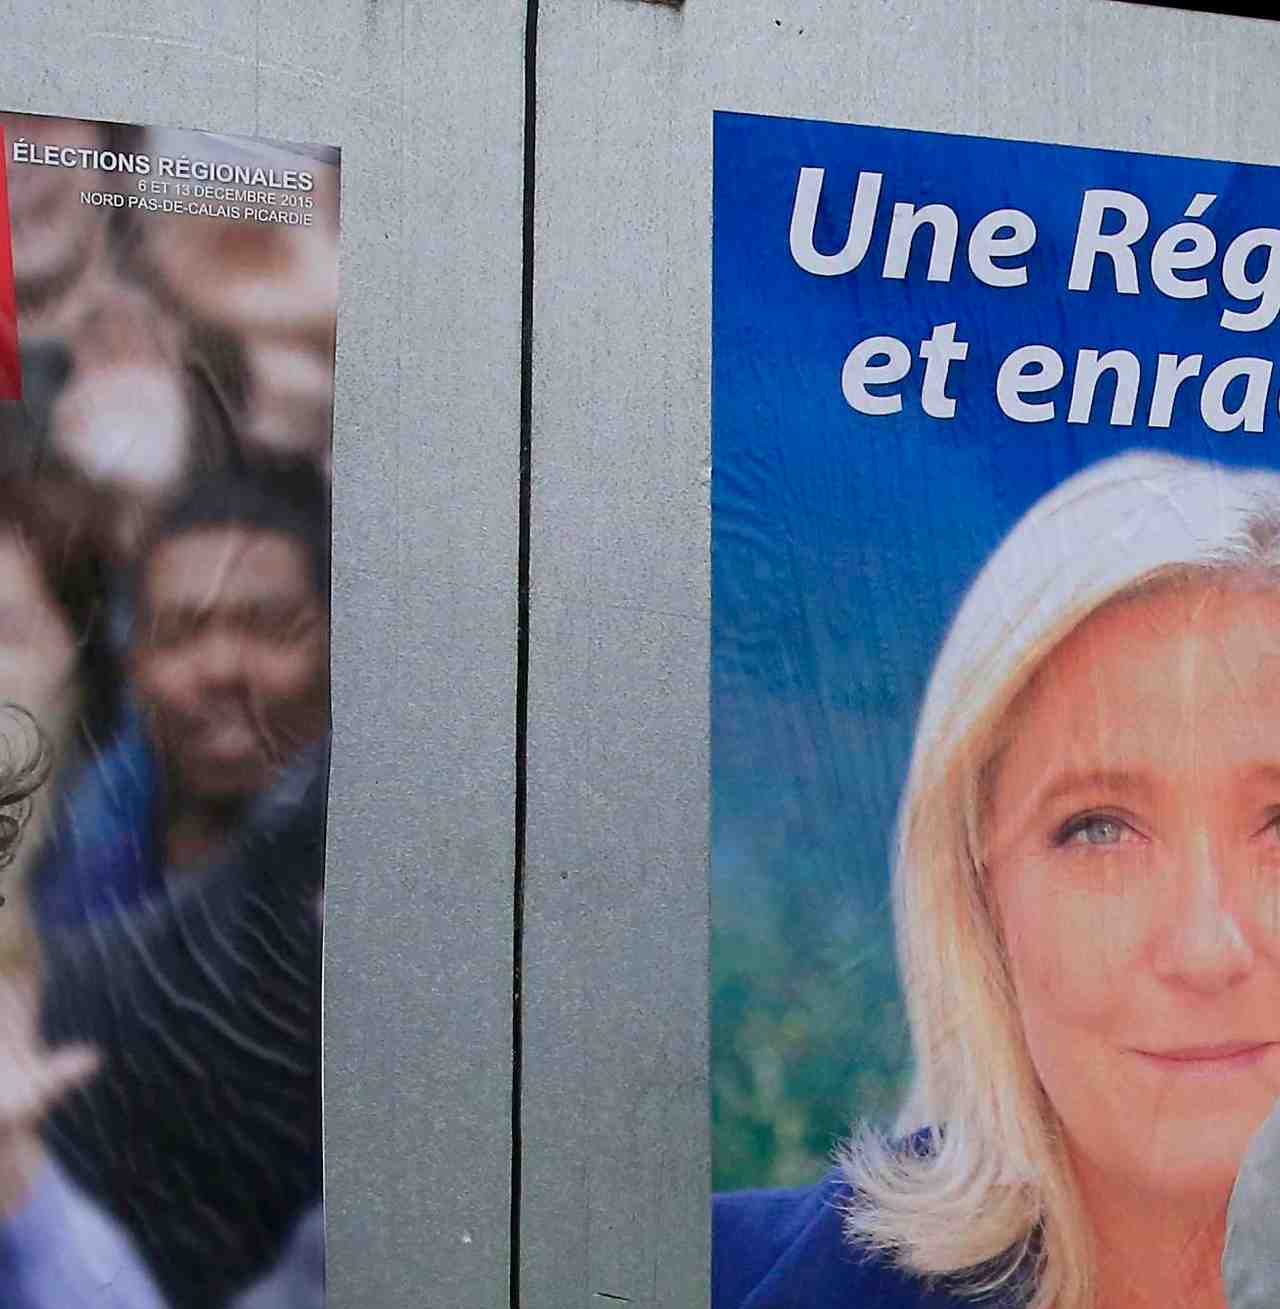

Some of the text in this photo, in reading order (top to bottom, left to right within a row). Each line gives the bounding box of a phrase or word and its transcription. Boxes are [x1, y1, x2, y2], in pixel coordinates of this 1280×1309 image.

[13, 138, 313, 190] ÉLECTIONS RÉGIONALES
[81, 191, 312, 226] NORD PAS-DE-CALAIS PICARDIE
[138, 180, 146, 192] 6
[151, 181, 169, 194] ET
[175, 183, 190, 196] 13
[280, 194, 313, 209] 2015
[788, 166, 1037, 288] Une
[841, 321, 969, 418] et
